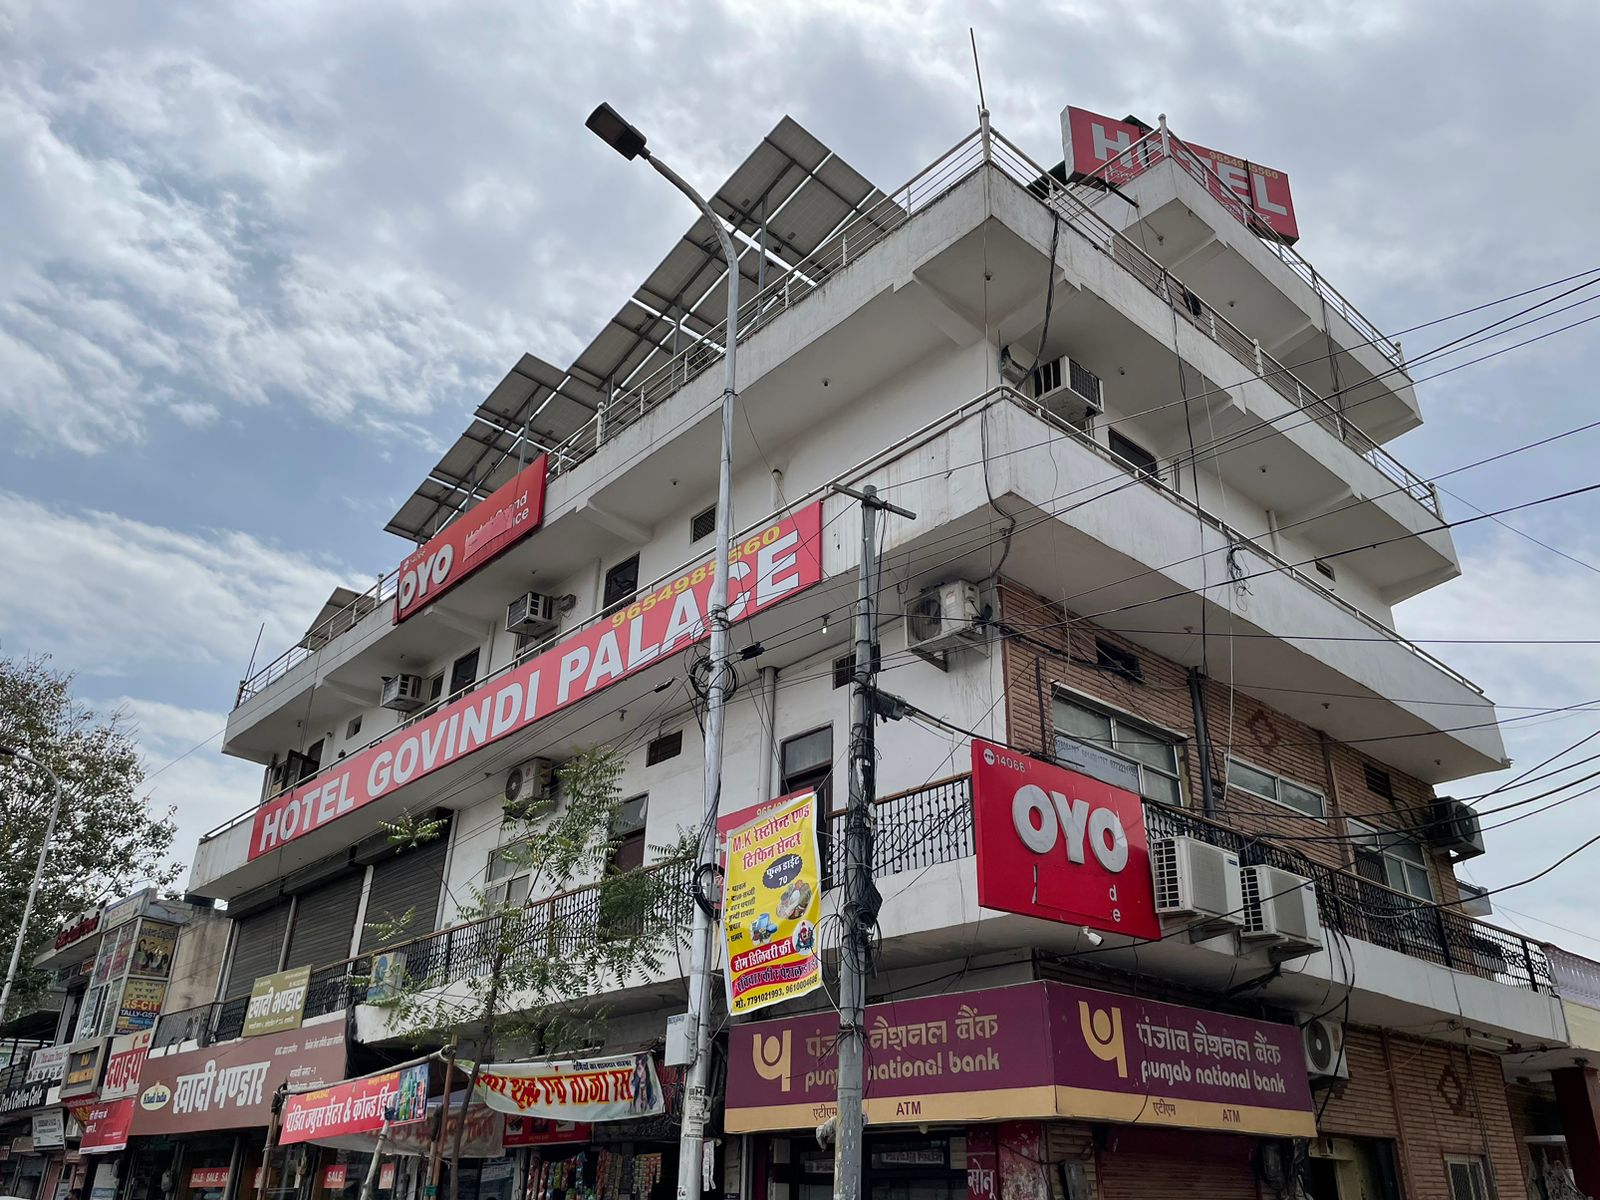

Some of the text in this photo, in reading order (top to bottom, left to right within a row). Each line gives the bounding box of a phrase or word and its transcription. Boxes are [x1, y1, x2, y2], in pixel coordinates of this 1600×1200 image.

[400, 543, 454, 610] OYO
[259, 529, 799, 852] HOTEL GOVINDI PALACE
[996, 754, 1026, 773] 14066
[733, 830, 752, 854] M.K
[1012, 784, 1129, 873] OYO
[778, 875, 788, 887] 70
[123, 999, 160, 1011] RS-CIT
[248, 986, 306, 1019] खादी भण्डार
[805, 1004, 999, 1057] पंज नैशनल बैंक
[1136, 1016, 1281, 1065] पंजाब नैशनल बैंक
[805, 1047, 1000, 1093] punj national bank
[1141, 1059, 1286, 1094] punjab national bank
[173, 1059, 271, 1114] खादी भण्डार
[565, 1070, 609, 1104] ताजा
[609, 1068, 633, 1103] रस
[344, 1096, 353, 1124] &
[896, 1101, 922, 1117] ATM
[1152, 1098, 1176, 1118] एटीएम
[1222, 1108, 1241, 1123] ATM
[326, 1171, 344, 1182] SALE
[383, 1170, 394, 1181] SA
